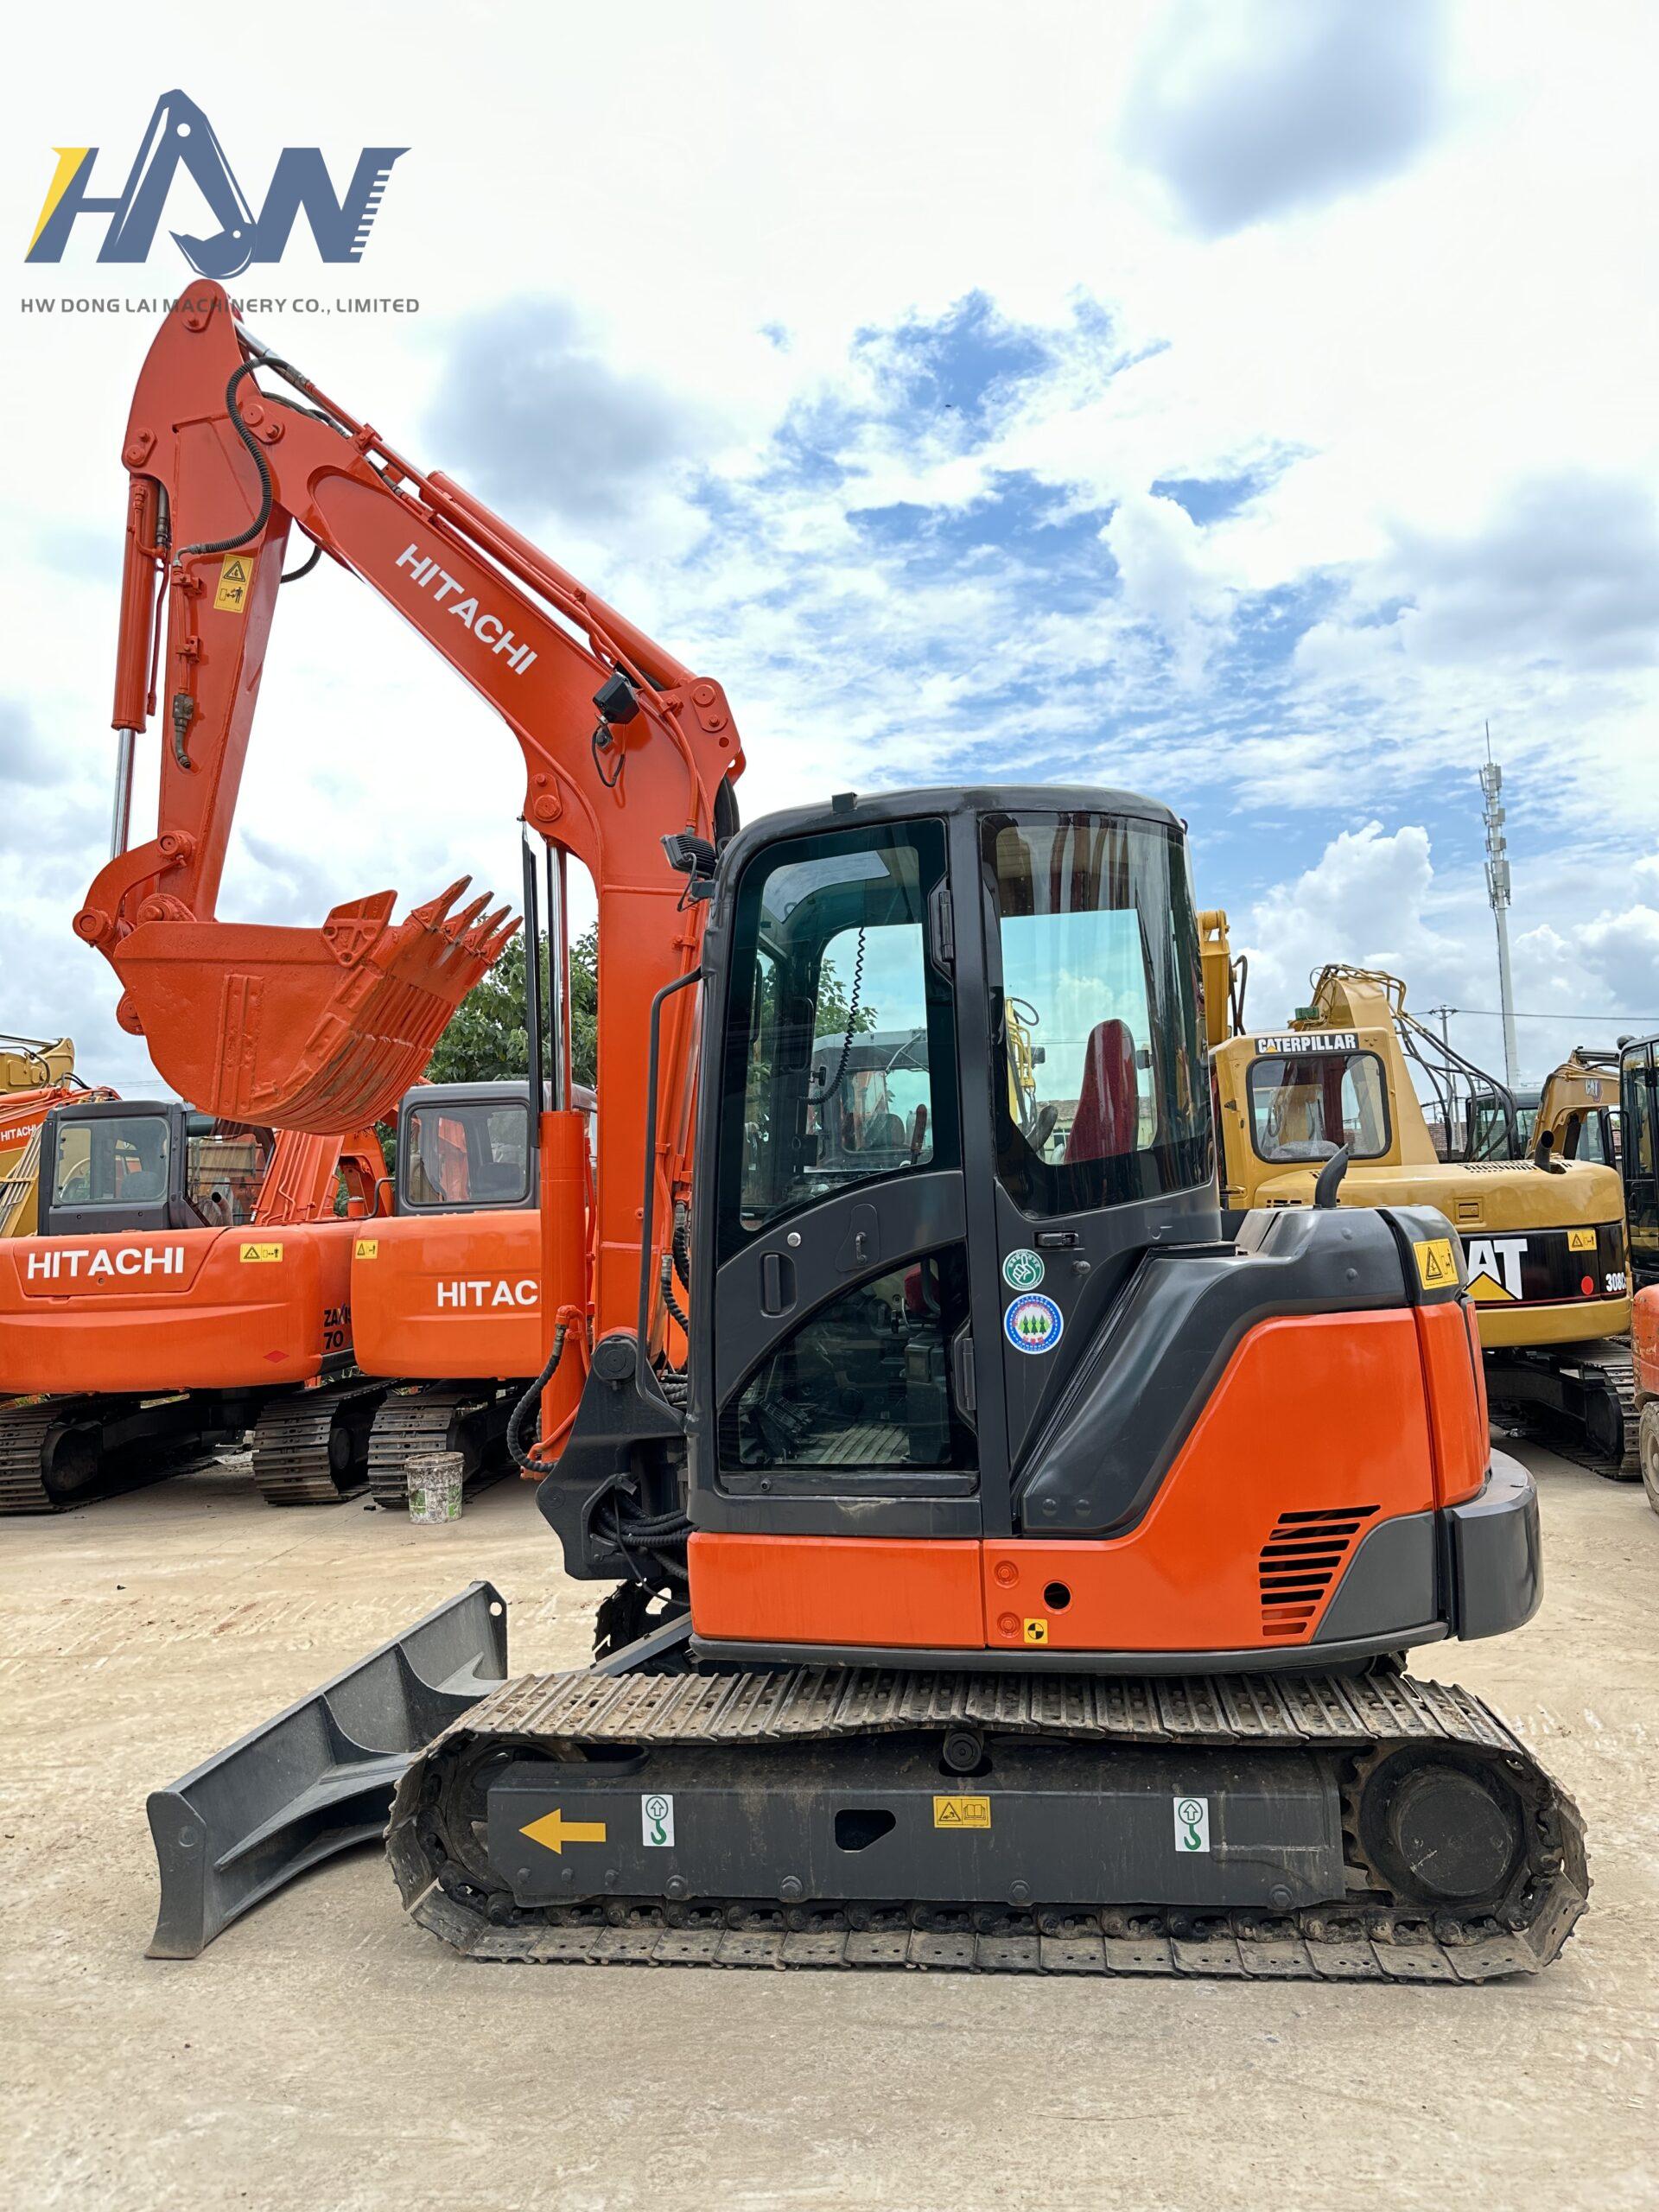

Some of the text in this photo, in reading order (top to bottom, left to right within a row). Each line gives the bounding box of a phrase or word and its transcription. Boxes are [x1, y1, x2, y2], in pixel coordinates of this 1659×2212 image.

[395, 543, 538, 676] HITACHI
[1258, 1034, 1357, 1053] CATERPILLAR
[27, 1246, 185, 1280] HITACHI
[1465, 1238, 1529, 1300] AT
[437, 1280, 542, 1307] HITAC
[323, 1330, 344, 1351] 70
